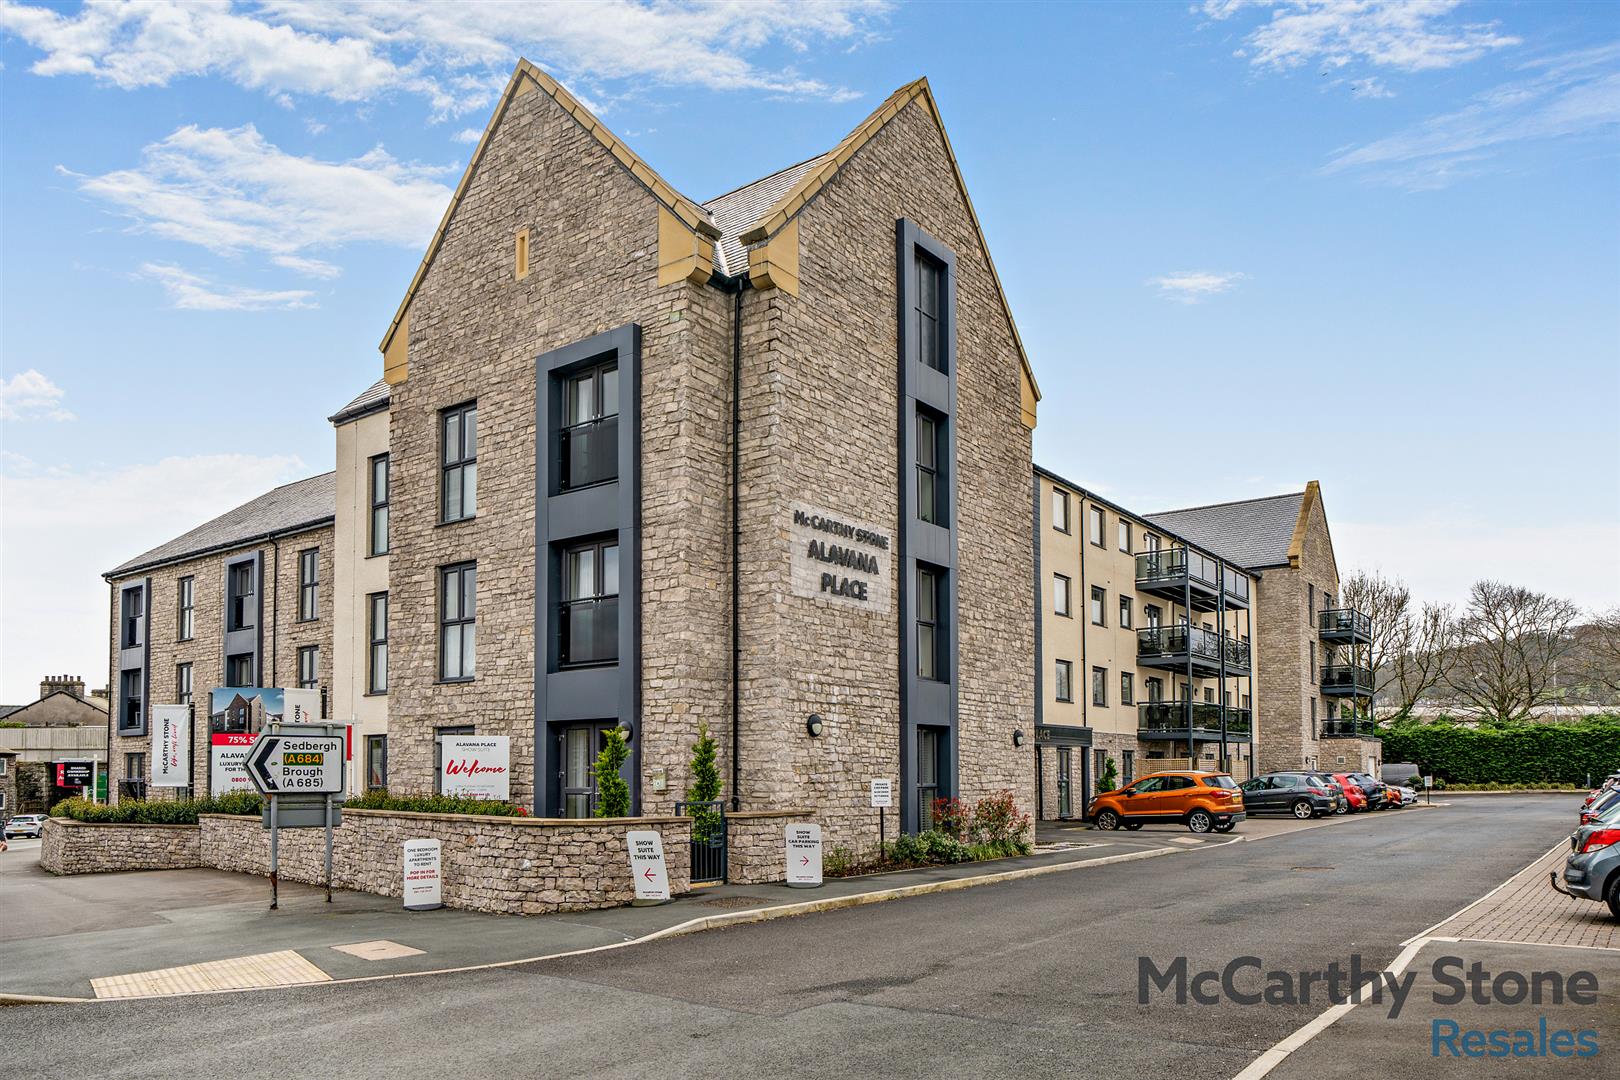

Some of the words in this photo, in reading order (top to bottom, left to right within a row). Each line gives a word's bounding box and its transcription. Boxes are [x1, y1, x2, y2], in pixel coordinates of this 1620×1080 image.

[794, 510, 855, 539] McCARTHY
[856, 528, 888, 550] STONE
[807, 539, 879, 575] ALAVANA
[821, 572, 868, 601] PLACE
[283, 741, 336, 752] Sedbergh
[283, 767, 322, 777] Brough
[446, 759, 506, 777] Welcome
